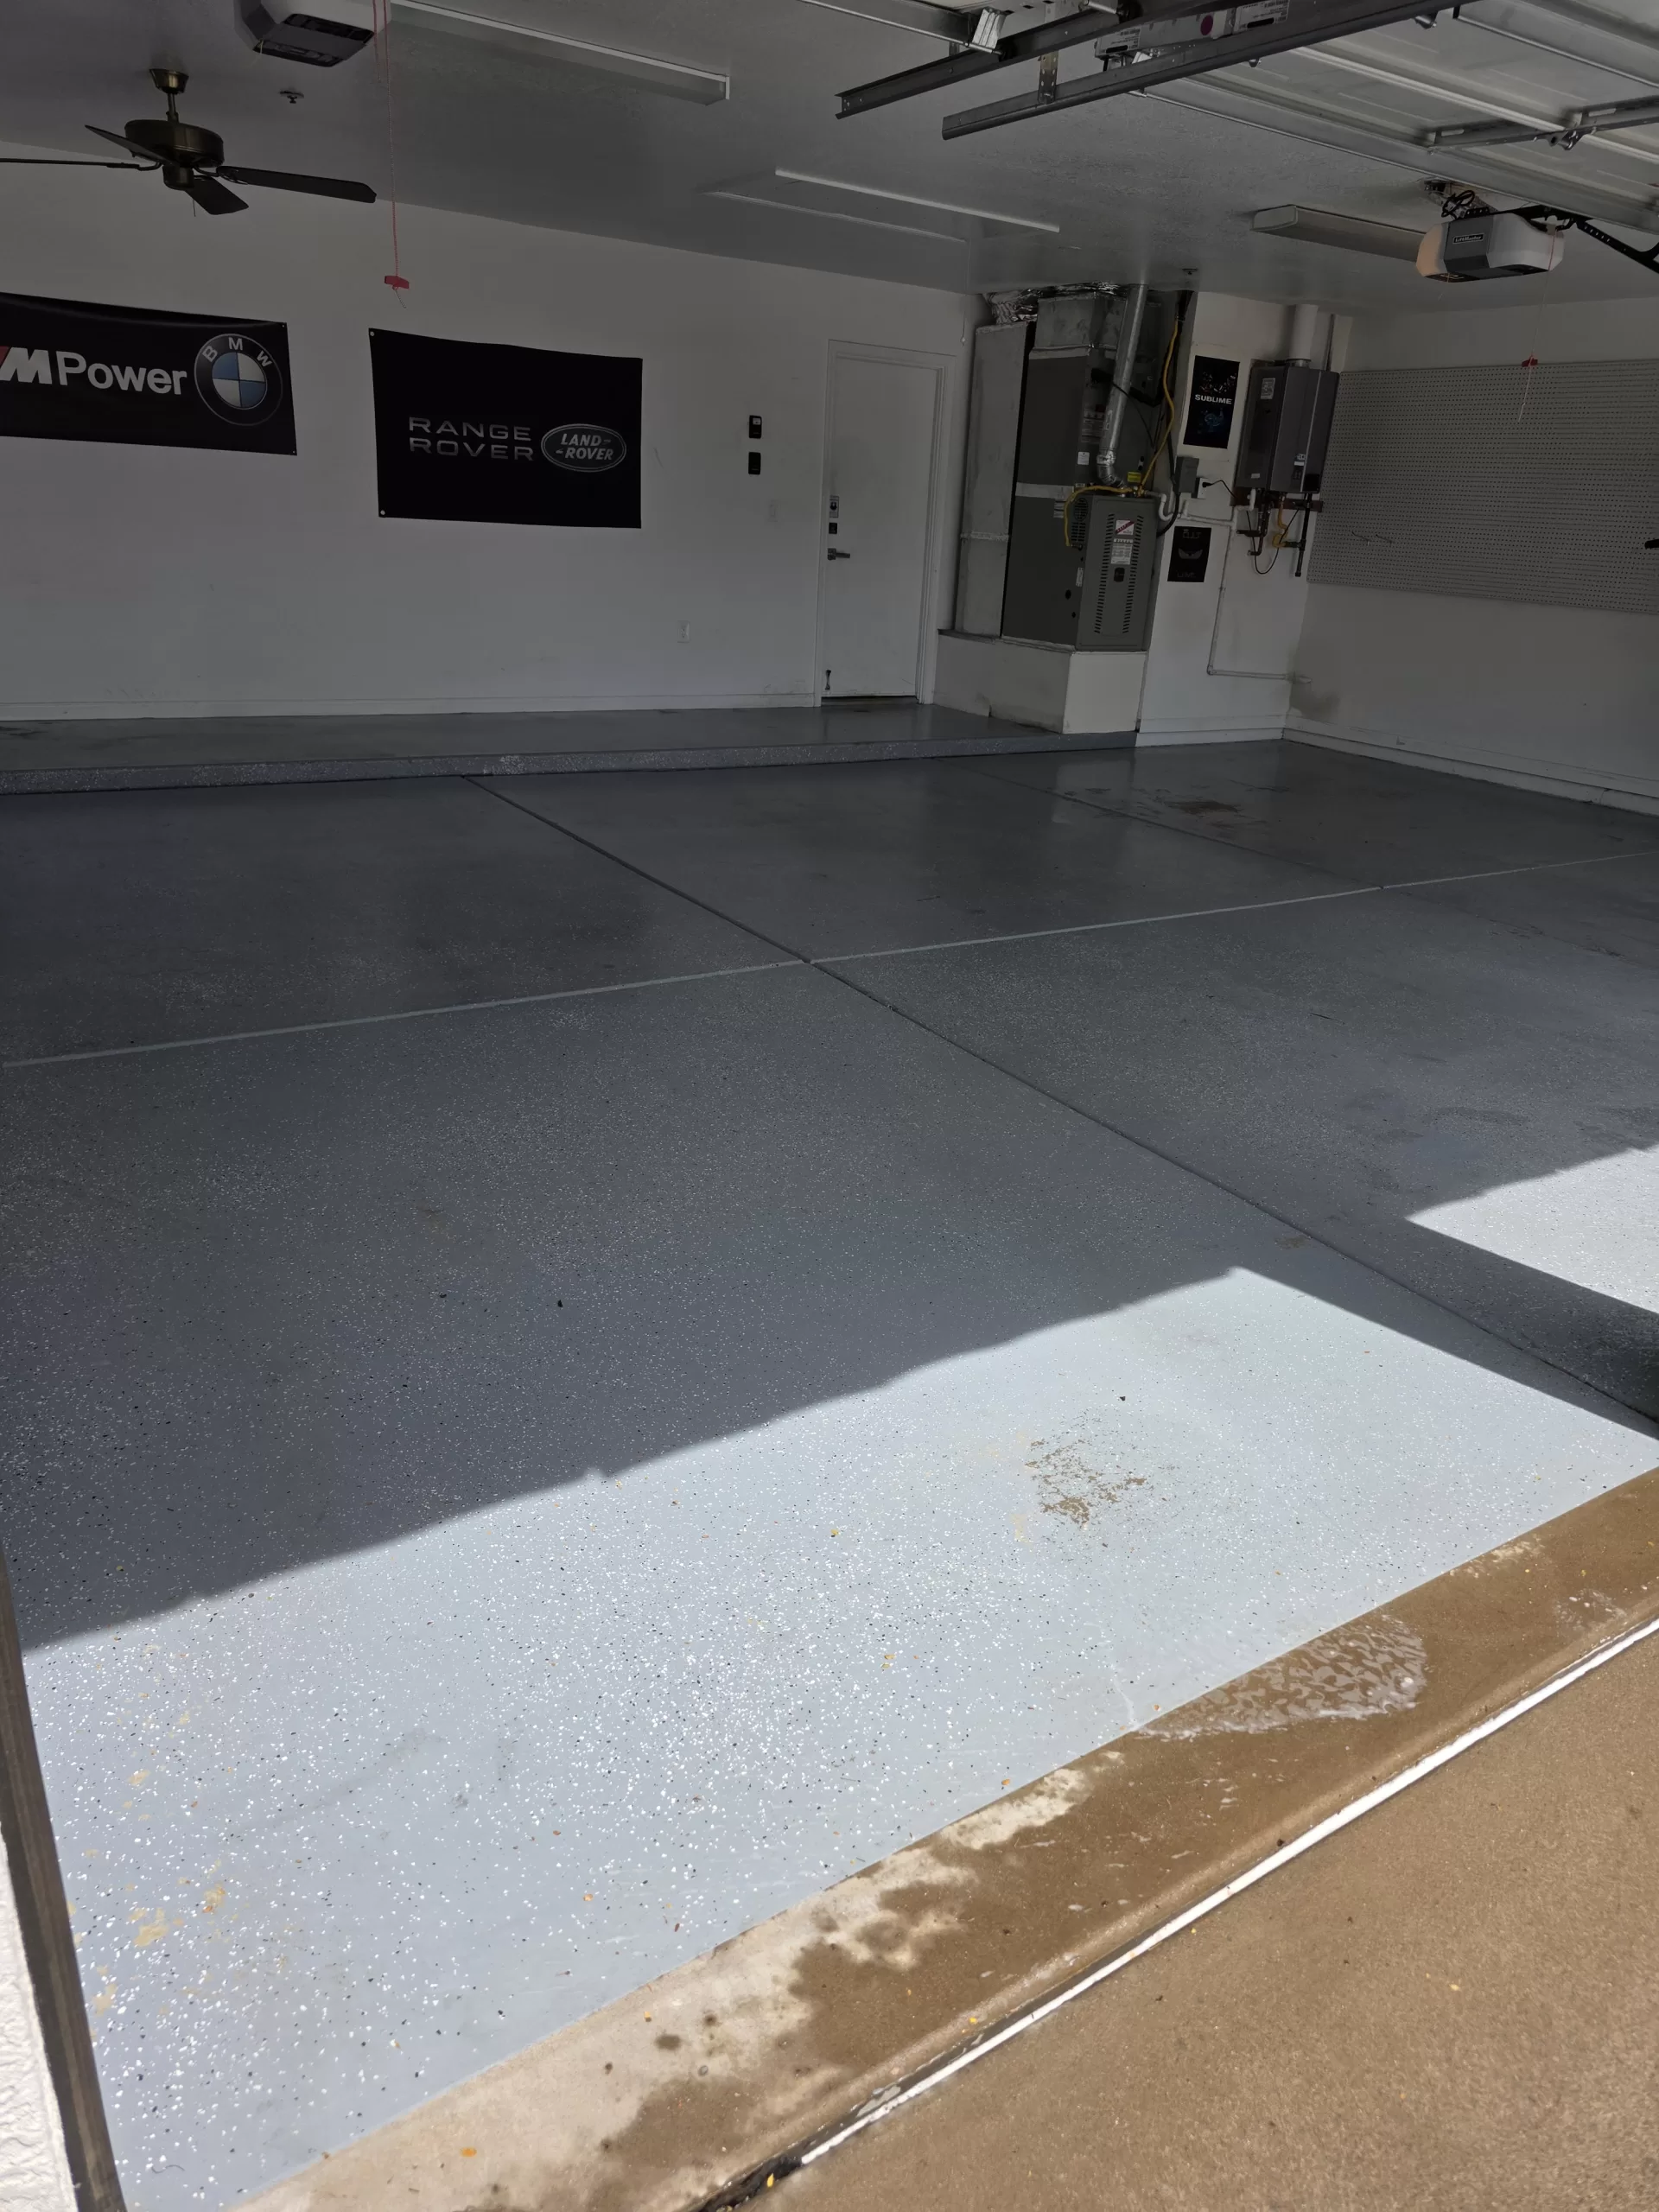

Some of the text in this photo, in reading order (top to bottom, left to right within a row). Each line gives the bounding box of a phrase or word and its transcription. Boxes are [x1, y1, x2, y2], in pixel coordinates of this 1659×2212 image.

[202, 337, 273, 368] BMW
[1194, 394, 1232, 405] SUBLIME
[408, 416, 532, 442] RANGE
[408, 436, 535, 461] ROVER
[560, 433, 602, 447] LAND
[564, 448, 615, 461] ROVER
